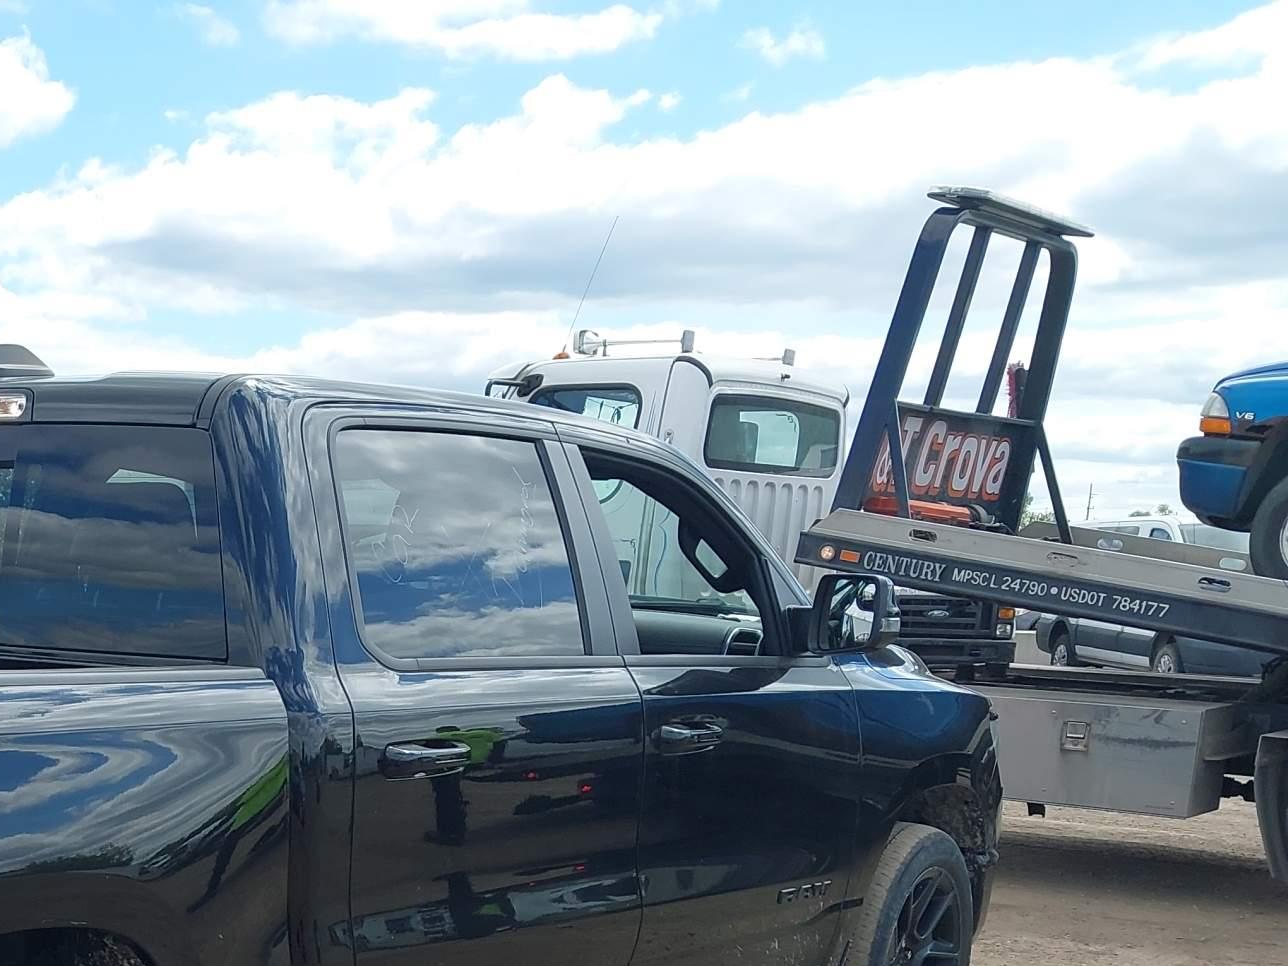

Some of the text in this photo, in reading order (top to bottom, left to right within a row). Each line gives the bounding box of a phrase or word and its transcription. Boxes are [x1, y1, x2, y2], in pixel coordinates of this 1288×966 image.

[1235, 411, 1255, 420] V6
[863, 551, 947, 582] CENTURY
[1001, 576, 1047, 596] 24790
[1061, 586, 1107, 607] USDOT
[1112, 595, 1170, 618] 784177
